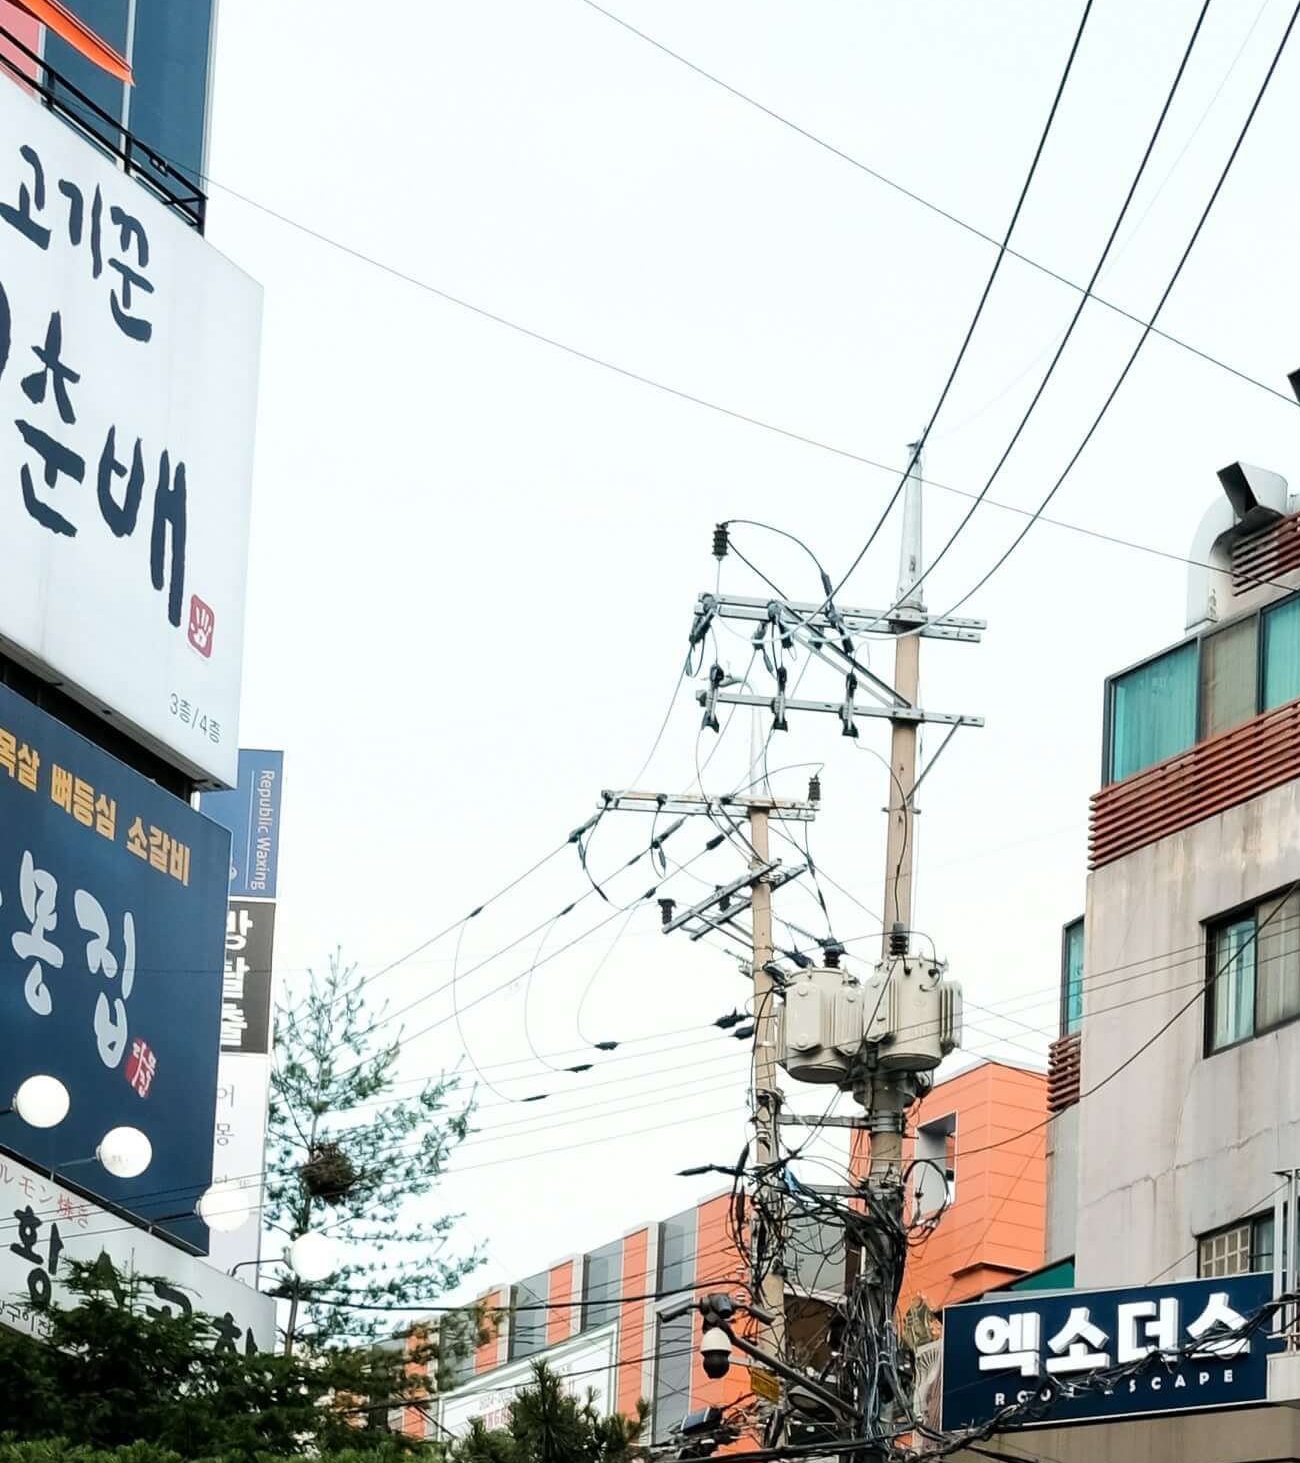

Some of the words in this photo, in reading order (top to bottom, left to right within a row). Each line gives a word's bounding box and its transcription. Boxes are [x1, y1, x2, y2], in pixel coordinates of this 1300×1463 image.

[0, 281, 187, 627] 춘배
[261, 768, 277, 830] Republic
[126, 815, 191, 887] 소갈비
[250, 832, 273, 891] Waxing
[0, 848, 136, 1069] 몽집
[975, 1291, 1251, 1378] 엑소더스
